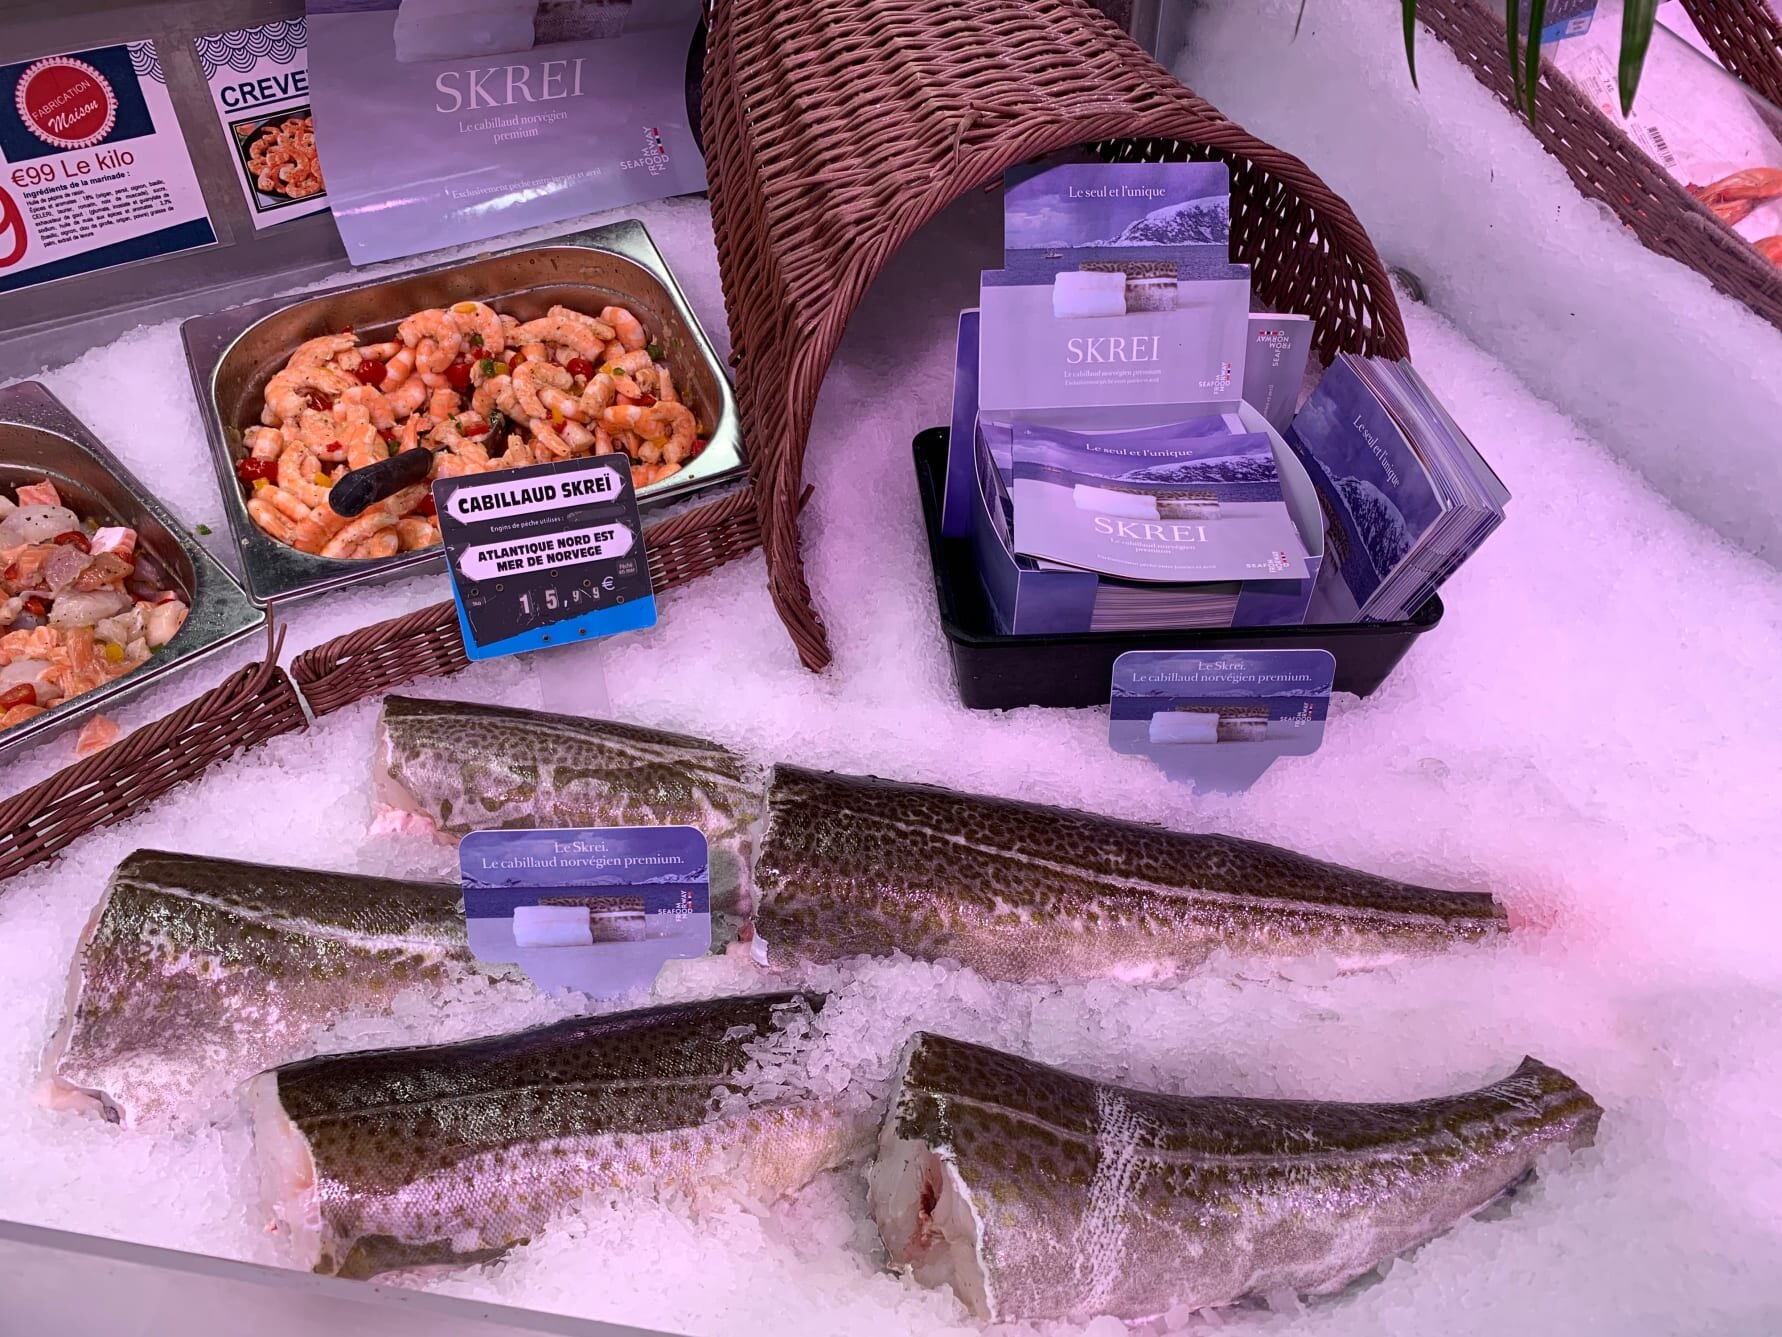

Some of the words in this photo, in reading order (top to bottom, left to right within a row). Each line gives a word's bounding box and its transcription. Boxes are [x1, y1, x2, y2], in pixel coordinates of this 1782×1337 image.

[221, 69, 309, 107] CREVE
[435, 58, 586, 113] SKREI
[32, 80, 91, 120] FABRICATION
[48, 100, 99, 133] Maison
[459, 120, 473, 133] Le
[474, 114, 519, 131] cabillaud
[520, 110, 568, 125] norvégien
[493, 127, 540, 145] premium
[11, 163, 56, 188] €99
[61, 158, 92, 179] Le
[95, 149, 135, 171] kilo
[620, 154, 670, 170] SEAFOOD
[22, 183, 68, 199] Ingrédients
[69, 180, 80, 188] de
[89, 171, 125, 184] marinade
[1069, 186, 1084, 198] Le
[1085, 185, 1107, 197] seul
[1108, 187, 1120, 197] et
[1121, 185, 1166, 200] l'unique
[1066, 336, 1161, 364] SKREI
[1086, 443, 1101, 452] Le
[1103, 447, 1127, 456] seul
[1143, 449, 1193, 458] l'unique
[1353, 414, 1365, 433] Le
[1362, 428, 1379, 448] seul
[1373, 444, 1382, 457] et
[1379, 449, 1400, 489] l'unique
[458, 485, 557, 514] CABILLAUD
[561, 473, 612, 499] SKREÏ
[490, 524, 511, 534] Engins
[511, 521, 520, 529] de
[1094, 516, 1209, 543] SKREI
[478, 539, 554, 563] ATLANTIQUE
[557, 534, 591, 549] NORD
[594, 530, 615, 543] EST
[496, 559, 524, 573] MER
[527, 556, 544, 568] DE
[547, 545, 603, 566] NORVEGE
[1132, 672, 1147, 682] Le
[1148, 672, 1199, 682] cabillaud
[1200, 672, 1255, 684] norvégien
[1257, 672, 1312, 684] premium.
[1198, 661, 1213, 671] Le
[1214, 660, 1246, 671] Skrei.
[554, 841, 572, 853] Le
[573, 840, 609, 853] Skrei.
[482, 857, 499, 869] Le
[500, 856, 557, 869] cabillaud
[560, 855, 622, 869] norvégien
[624, 853, 685, 868] premium.
